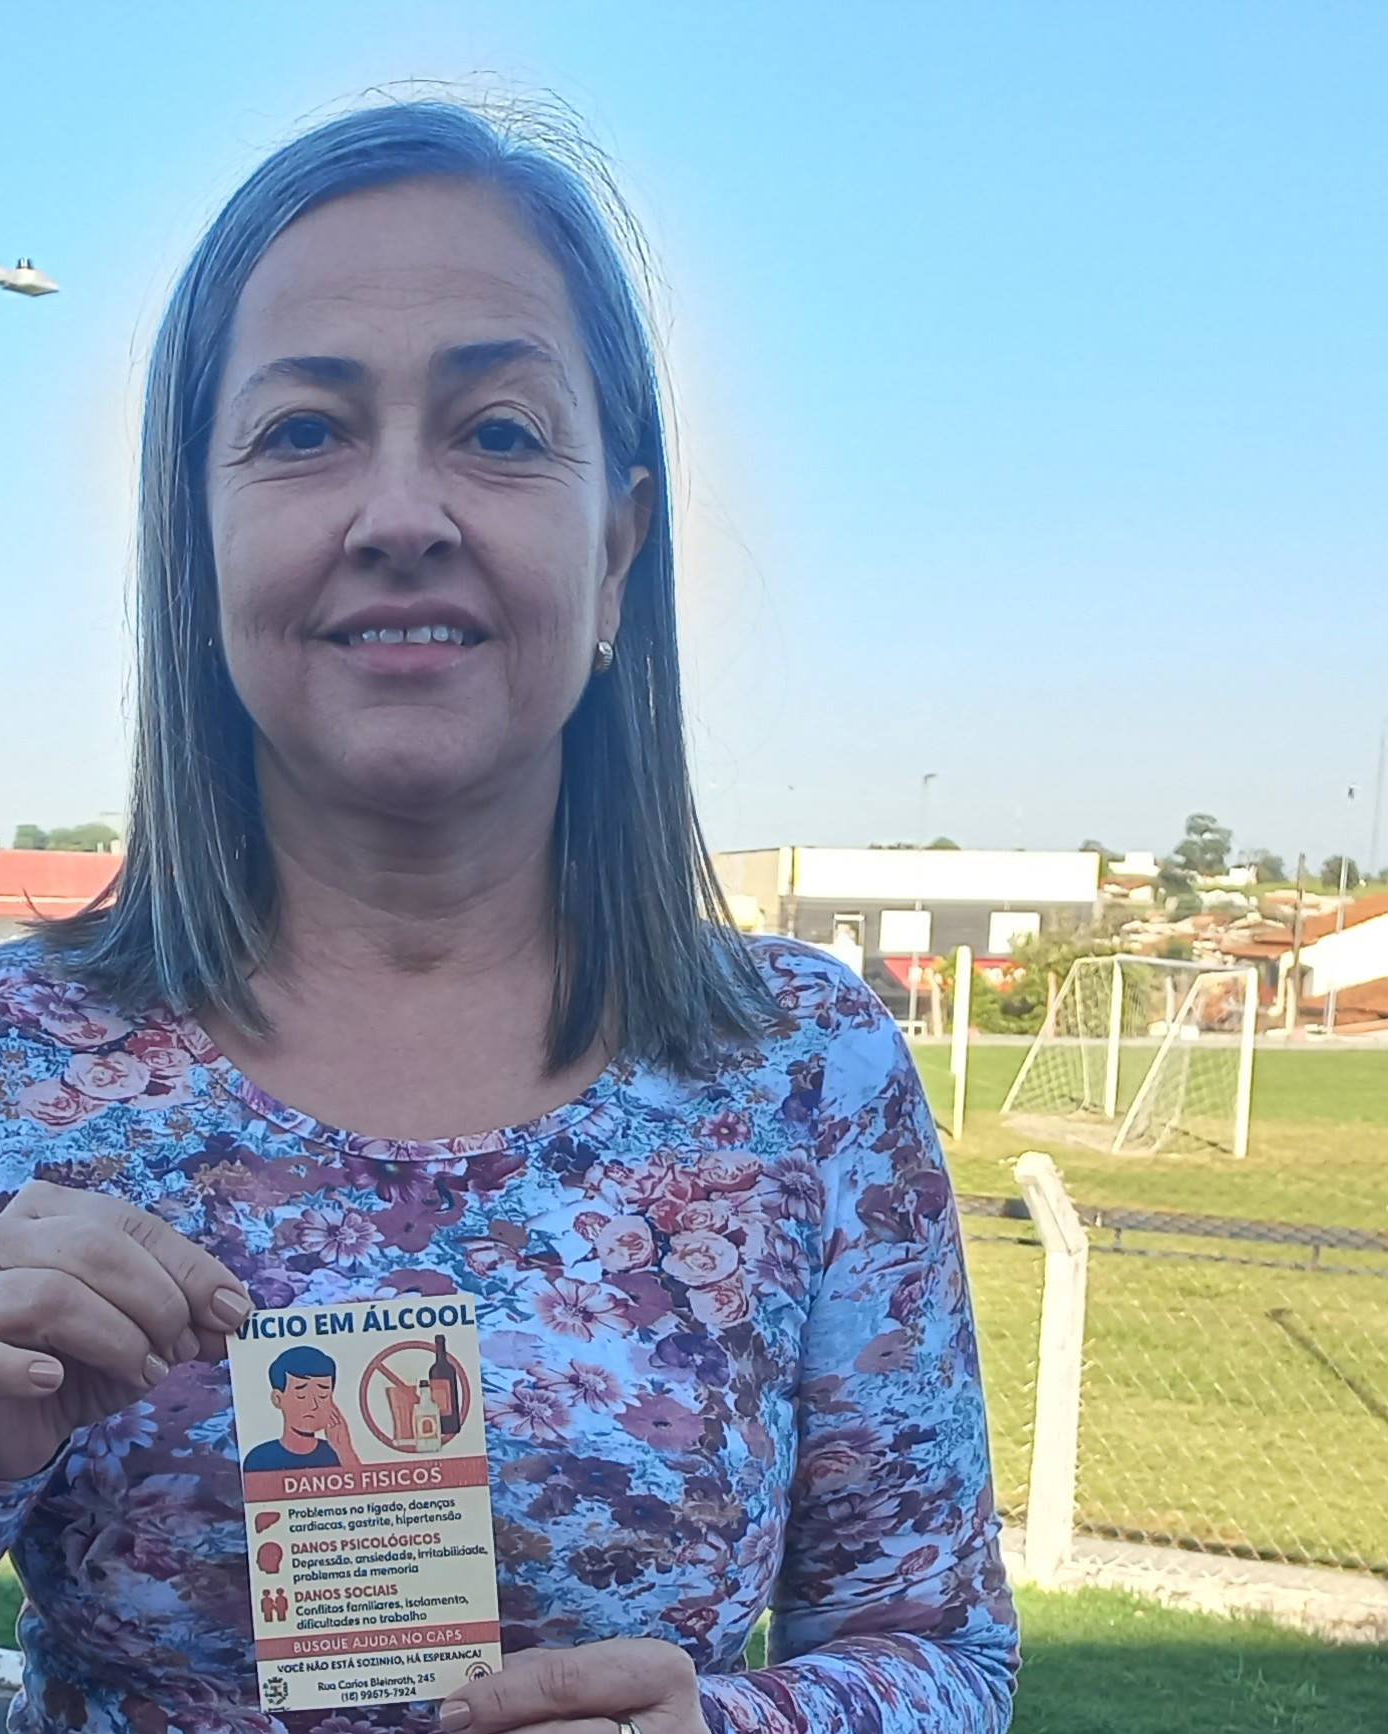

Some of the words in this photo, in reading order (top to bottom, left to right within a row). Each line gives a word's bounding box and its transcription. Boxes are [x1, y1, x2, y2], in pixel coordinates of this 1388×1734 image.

[235, 1312, 307, 1340] VÍCIO
[315, 1312, 354, 1335] EM
[362, 1305, 475, 1332] ÁLCOOL
[284, 1474, 355, 1494] DANOS
[288, 1506, 348, 1519] Problemas
[350, 1506, 365, 1515] no
[408, 1498, 455, 1512] doenças
[348, 1517, 393, 1531] gastrite,
[396, 1511, 462, 1526] hipertensão
[291, 1539, 337, 1555] DANOS
[341, 1532, 441, 1551] PSICOLÓGICOS
[355, 1551, 416, 1564] ansiedade,
[418, 1544, 488, 1560] irritabilidade,
[293, 1570, 351, 1585] problemas
[294, 1588, 341, 1603] DANOS
[344, 1584, 398, 1598] SOCIAIS
[295, 1603, 344, 1616] Conflitos
[346, 1599, 404, 1612] familiares,
[405, 1595, 469, 1608] isolamento,
[363, 1617, 377, 1625] no
[380, 1611, 427, 1624] trabalho
[293, 1636, 348, 1653] BUSQUE
[352, 1634, 398, 1648] AJUDA
[402, 1631, 422, 1644] NO
[426, 1629, 462, 1643] CAPS
[277, 1661, 305, 1674] VOCÊ
[306, 1659, 329, 1672] NÃO
[331, 1656, 354, 1670] ESTÁ
[357, 1654, 405, 1668] SOZINHO,
[406, 1652, 421, 1665] HÁ
